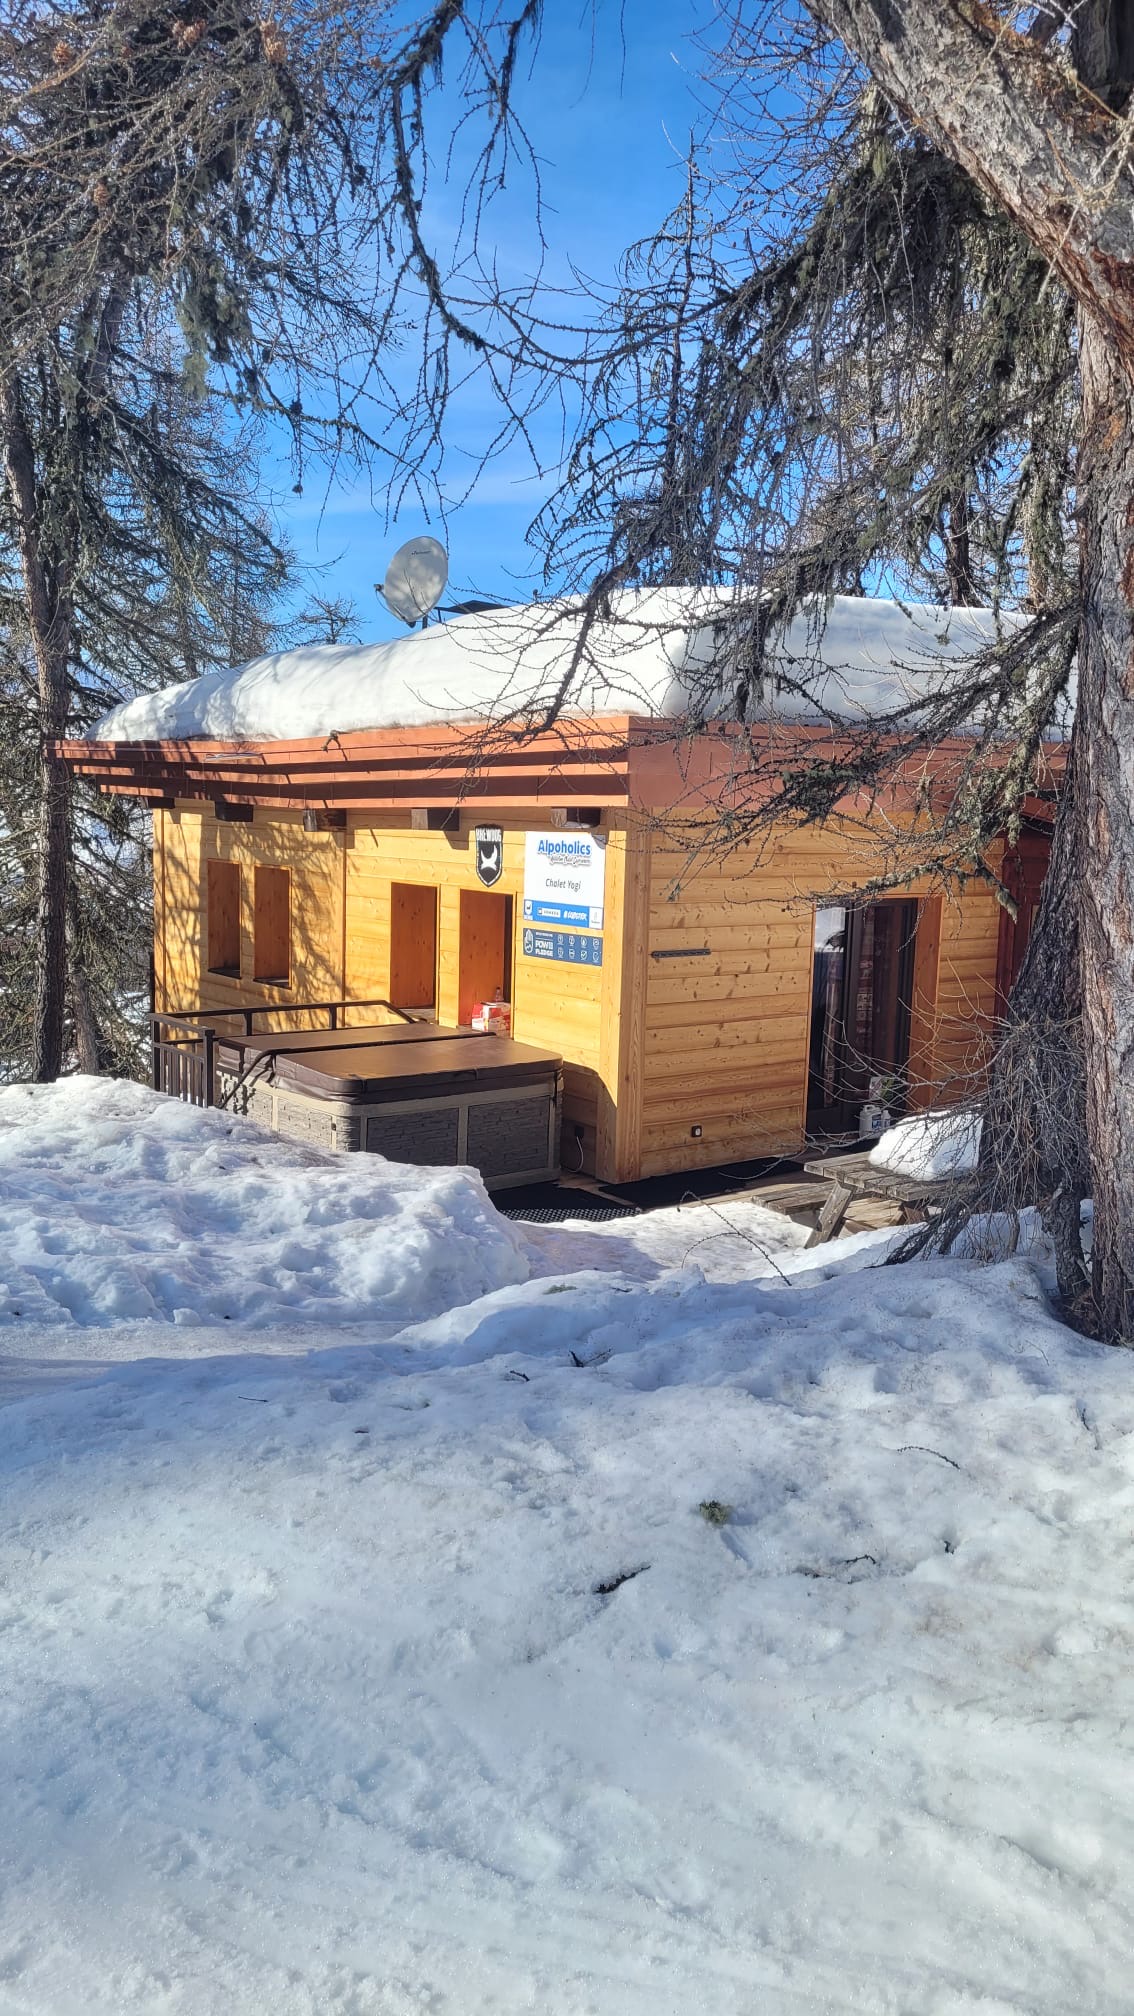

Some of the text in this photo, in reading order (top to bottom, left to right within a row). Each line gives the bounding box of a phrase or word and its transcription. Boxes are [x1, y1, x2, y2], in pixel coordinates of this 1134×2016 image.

[538, 839, 591, 855] Alpoholics
[545, 878, 582, 893] Chalet Yogi
